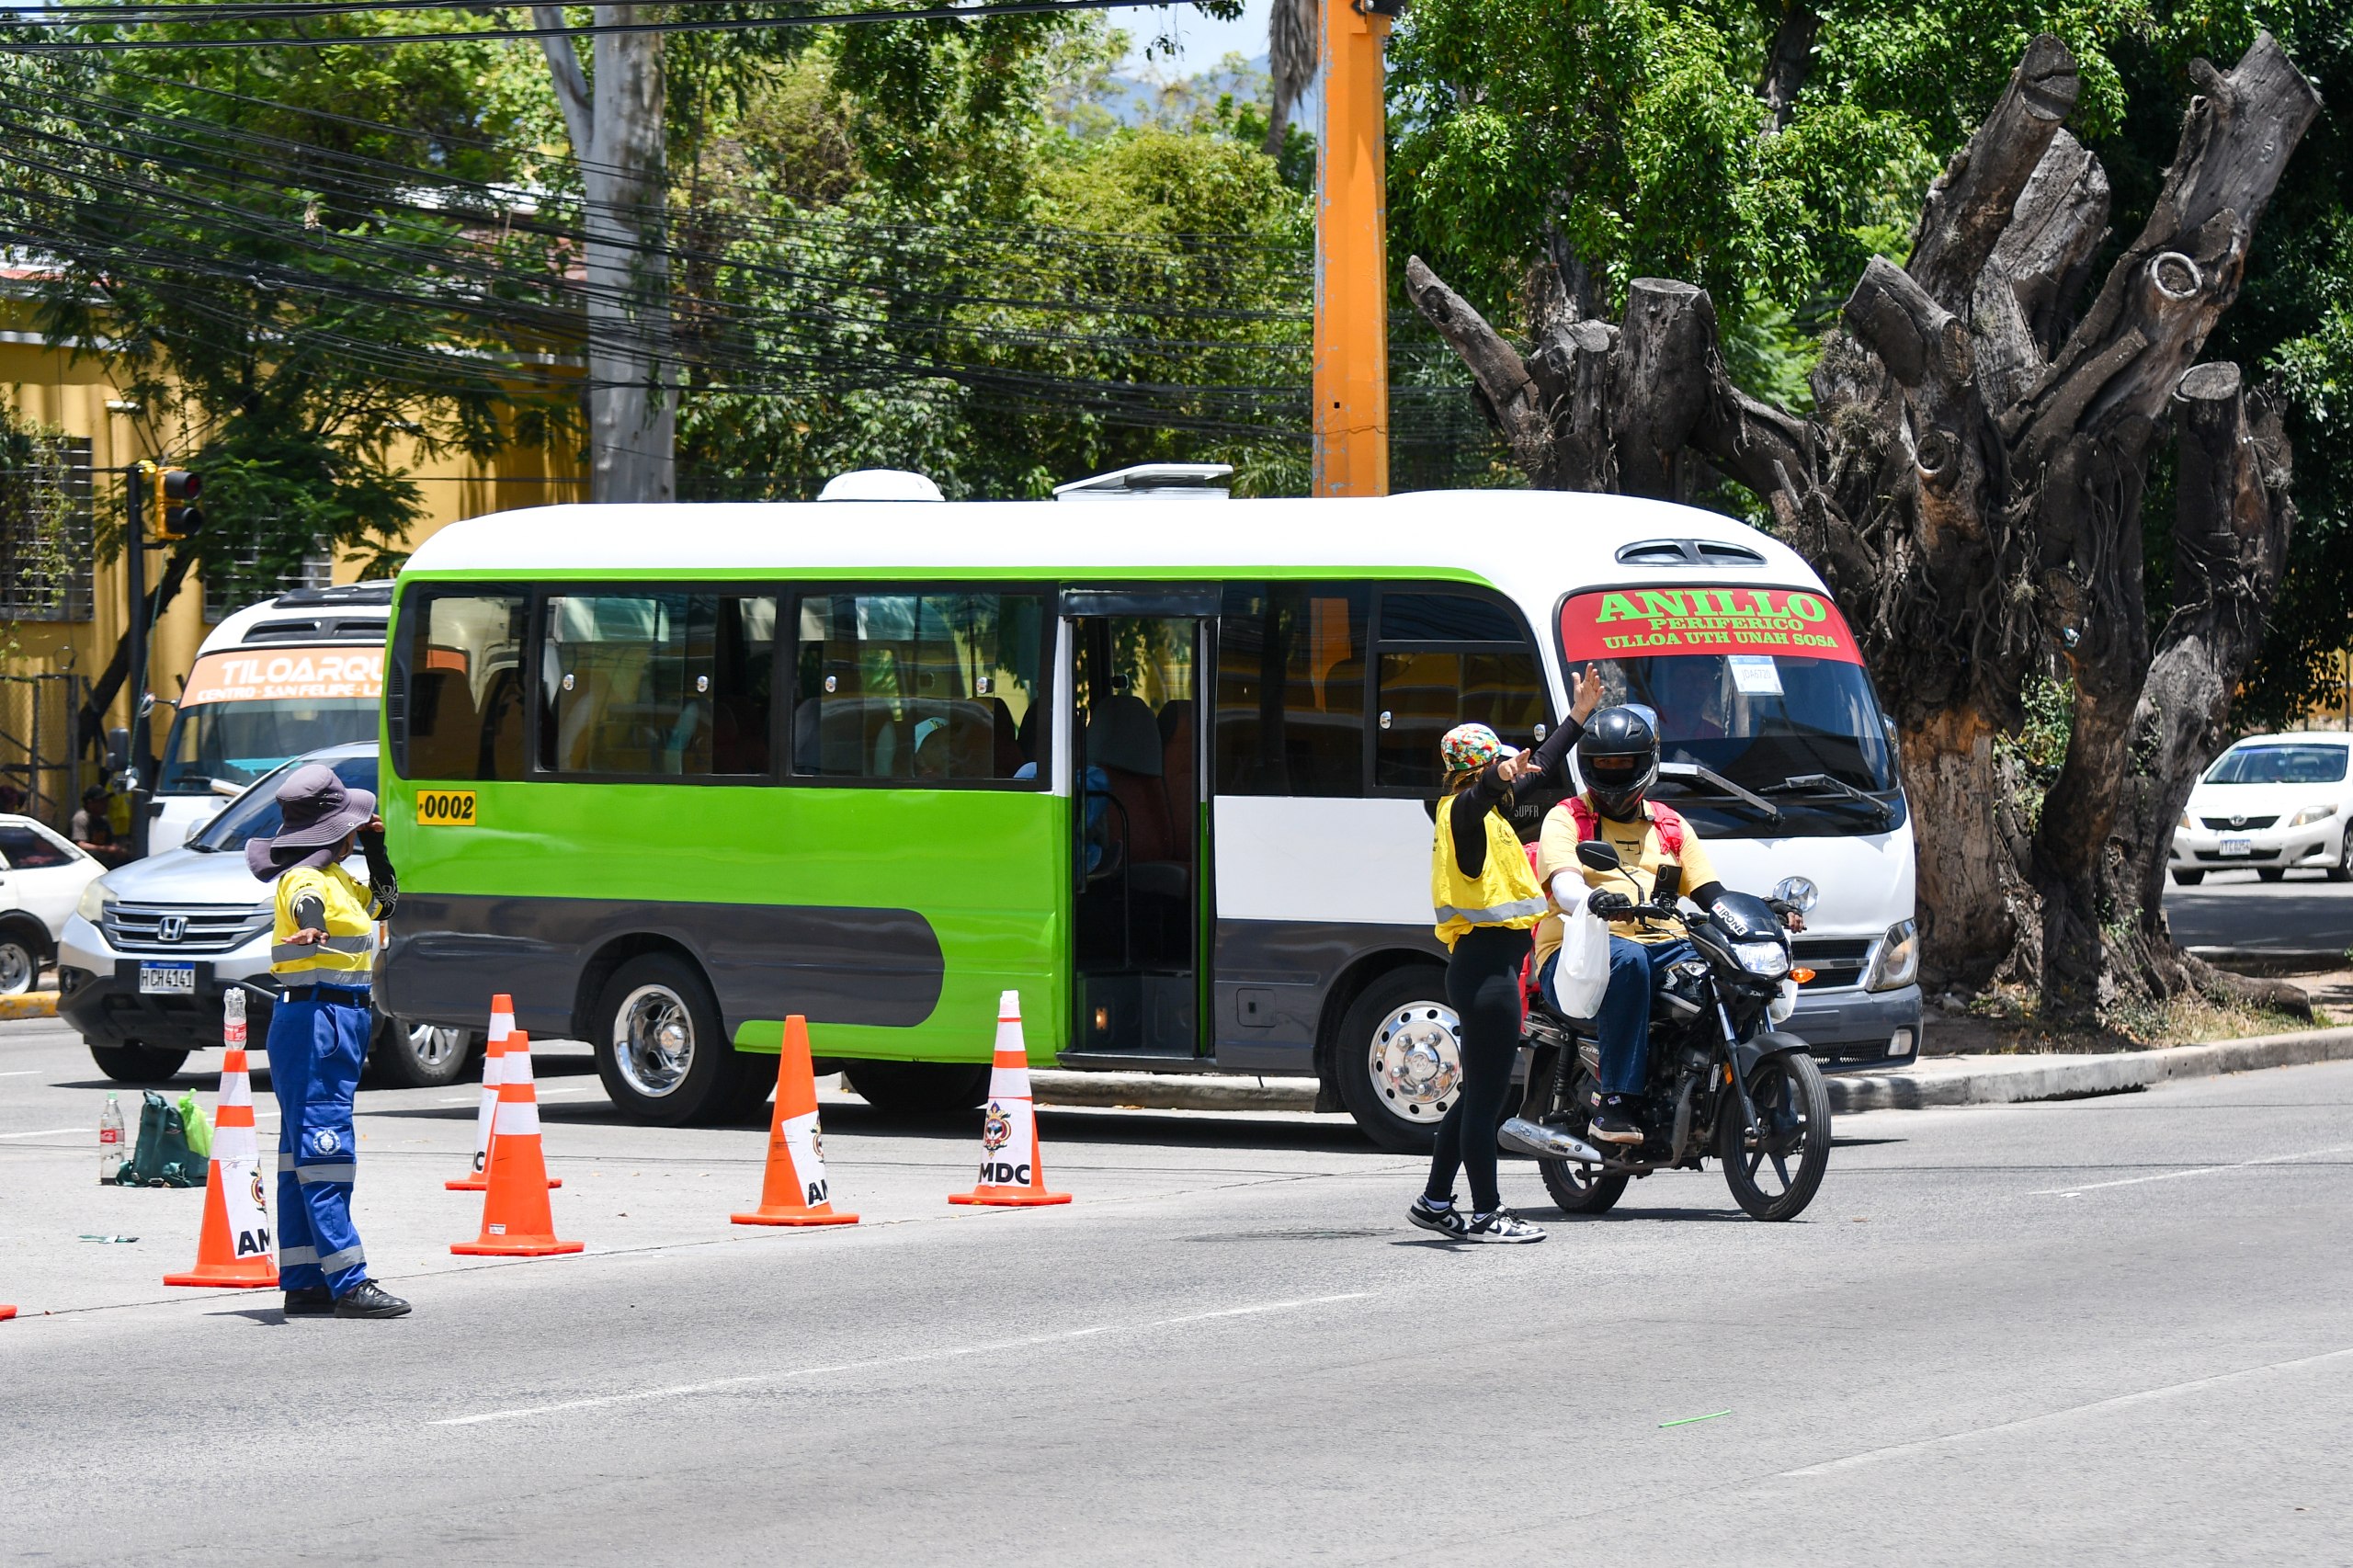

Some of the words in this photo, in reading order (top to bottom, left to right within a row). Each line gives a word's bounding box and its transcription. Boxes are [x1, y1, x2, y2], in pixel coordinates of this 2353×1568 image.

[1596, 590, 1826, 623] ANILLO
[1648, 617, 1804, 631] PERIFERICO
[1603, 633, 1682, 649] ULLOA
[1685, 631, 1731, 644] UTH
[1734, 631, 1790, 645] UNAH
[1792, 633, 1838, 648] SOSA
[197, 686, 255, 702] CENTRO
[262, 686, 297, 697] SAN
[298, 684, 356, 697] FELIPE
[1719, 908, 1745, 935] IPONE
